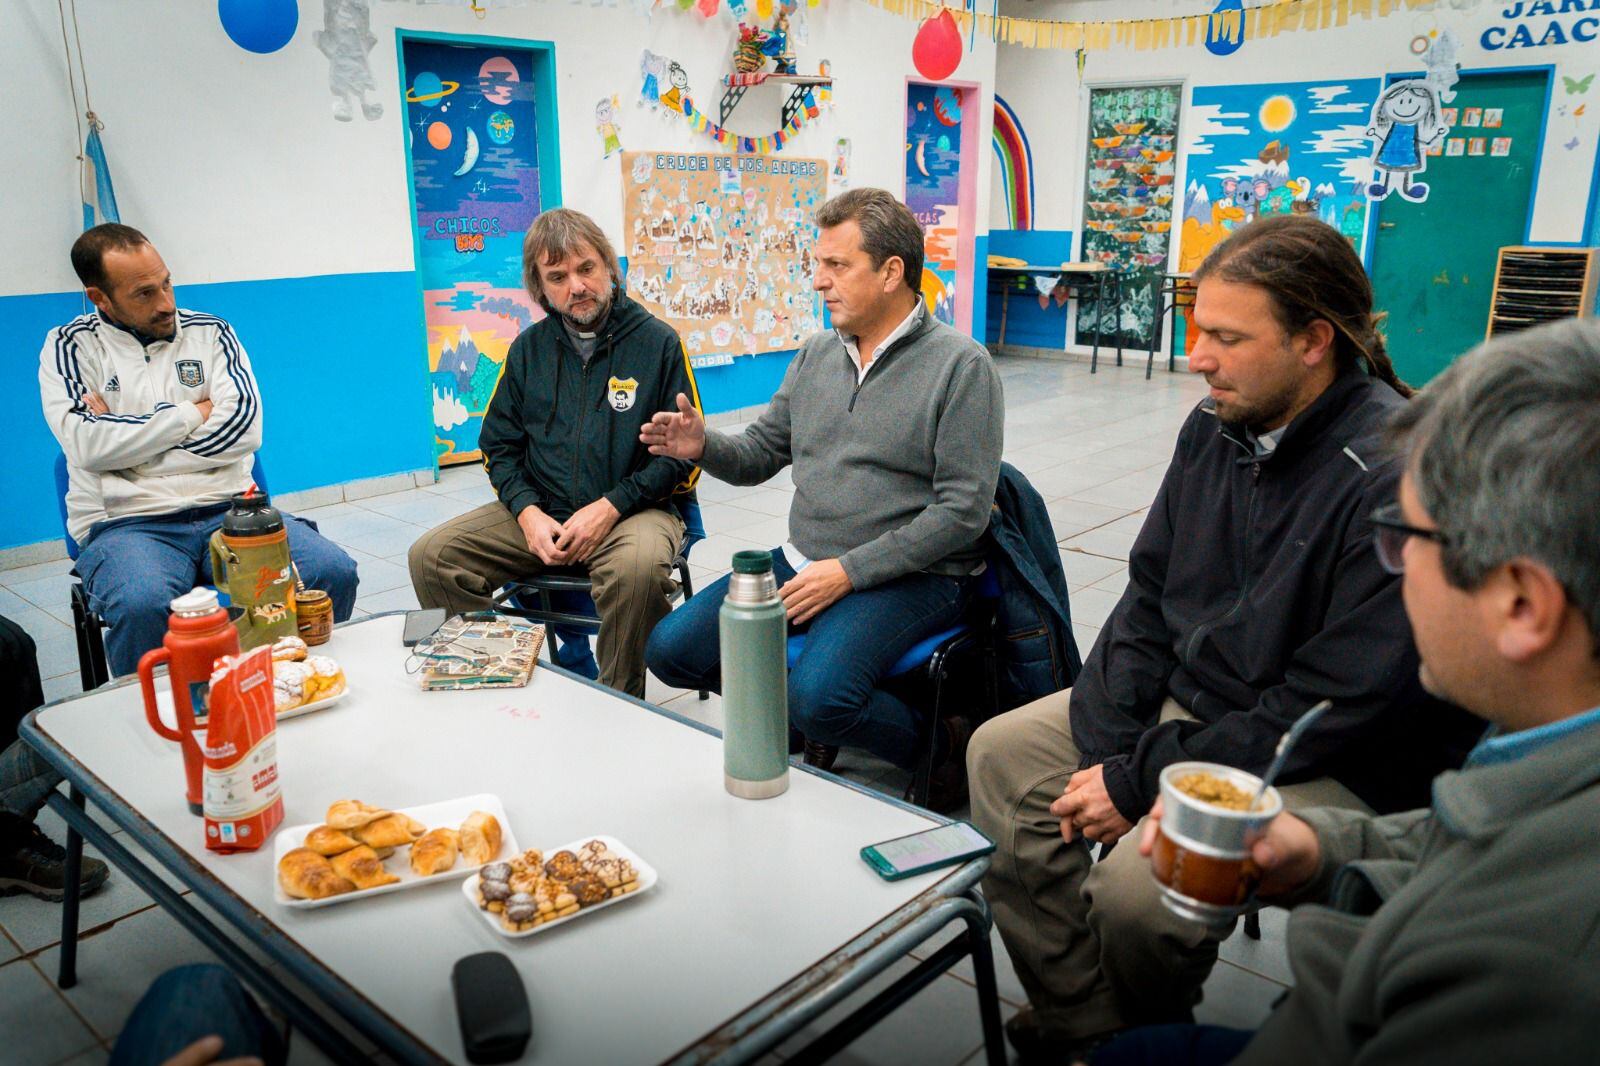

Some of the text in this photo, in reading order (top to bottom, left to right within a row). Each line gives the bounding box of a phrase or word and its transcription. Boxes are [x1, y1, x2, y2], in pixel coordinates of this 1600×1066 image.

[1502, 0, 1600, 19] JAR
[1480, 17, 1599, 51] CAAC
[656, 155, 817, 175] CRUCE DE LOS ANDES
[434, 217, 500, 234] CHICOS
